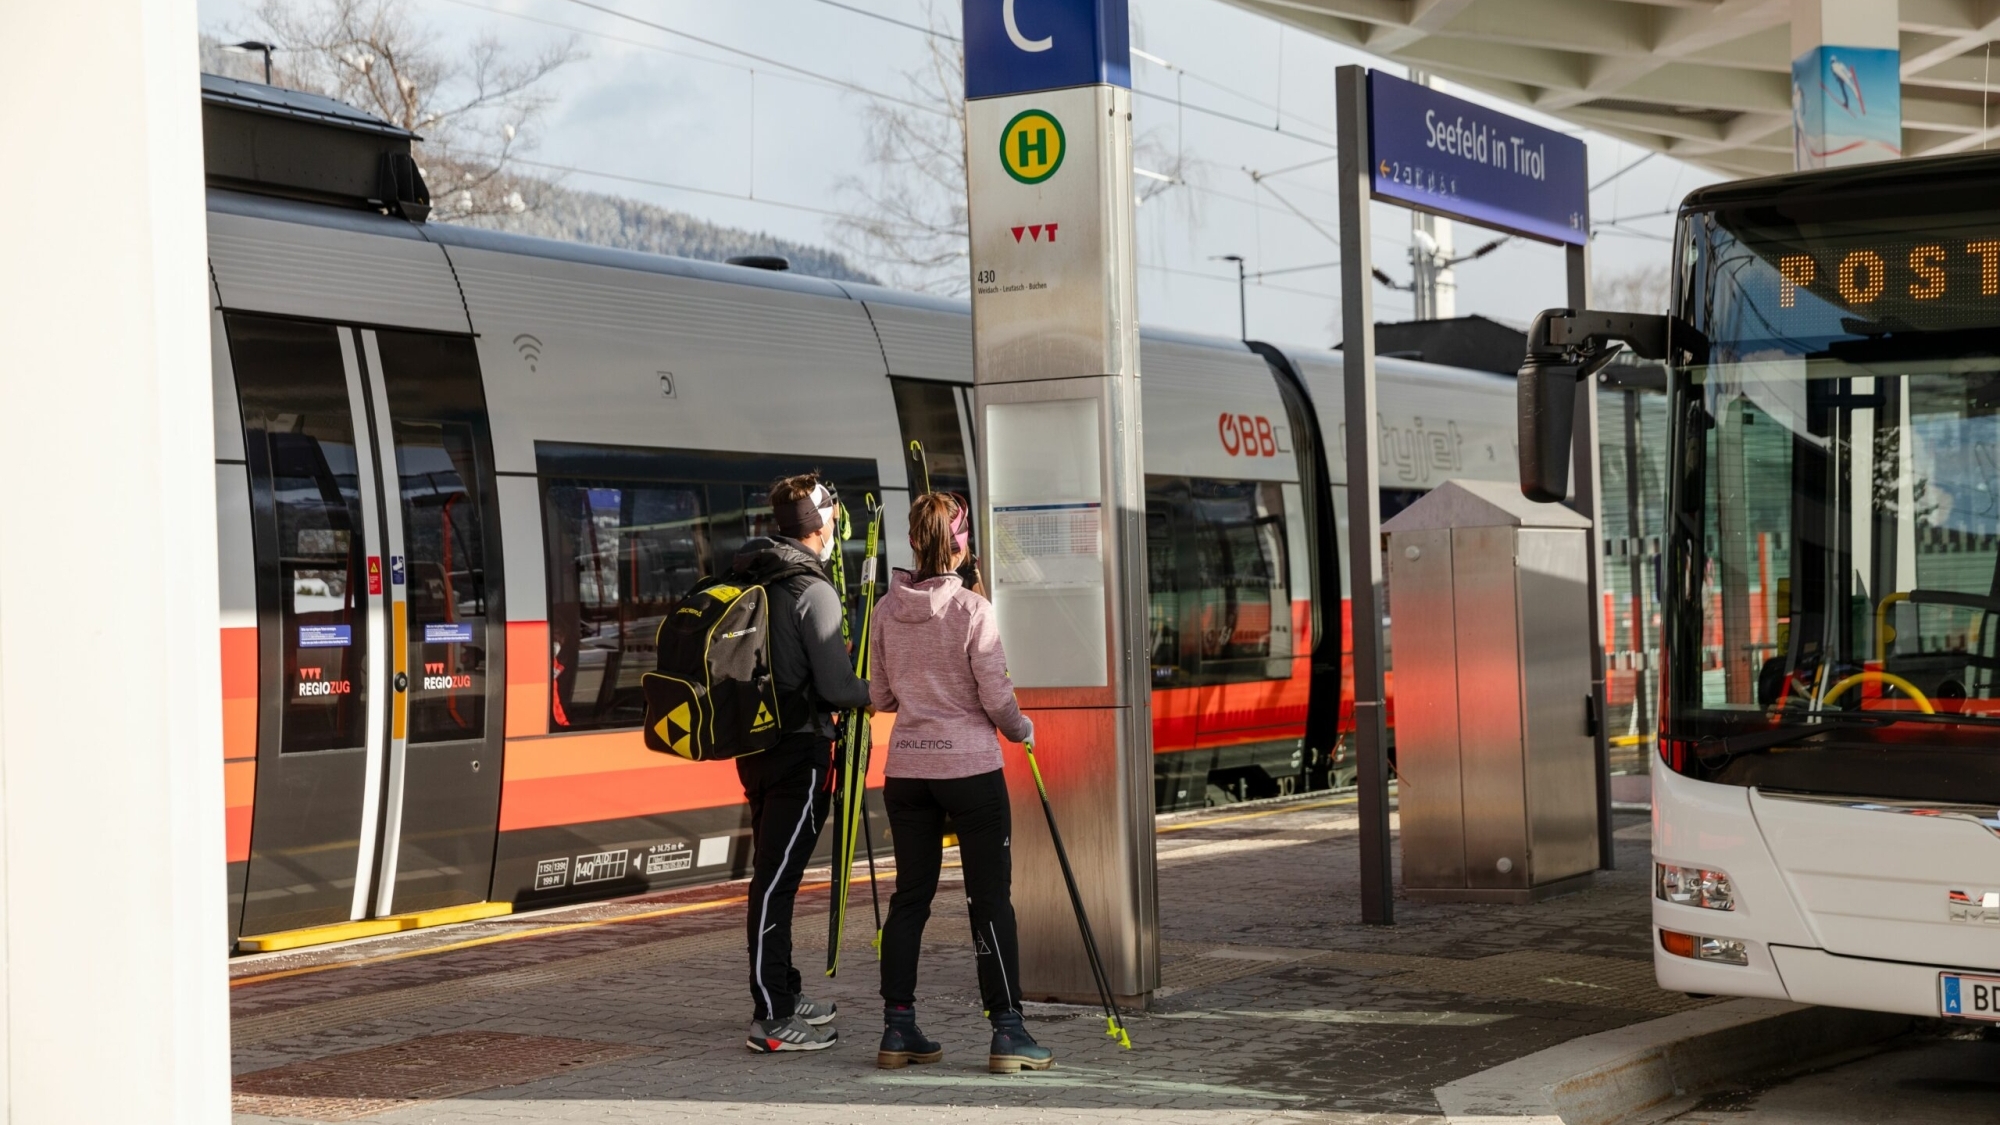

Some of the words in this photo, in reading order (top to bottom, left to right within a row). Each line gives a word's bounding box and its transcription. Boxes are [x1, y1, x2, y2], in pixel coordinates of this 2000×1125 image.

[1018, 128, 1048, 168] H
[1425, 109, 1488, 164] Seefeld
[1492, 128, 1508, 170] in
[1510, 136, 1545, 182] Tirol
[1393, 161, 1400, 183] 2
[977, 269, 996, 284] 430
[1780, 241, 2000, 308] POST
[978, 286, 999, 294] Weidach
[1003, 283, 1025, 293] Leutasch
[299, 681, 351, 696] REGIOZUG
[424, 675, 471, 690] REGIOZUG
[895, 740, 953, 750] #SKILETICS
[576, 861, 594, 878] 140
[1949, 999, 1958, 1008] A
